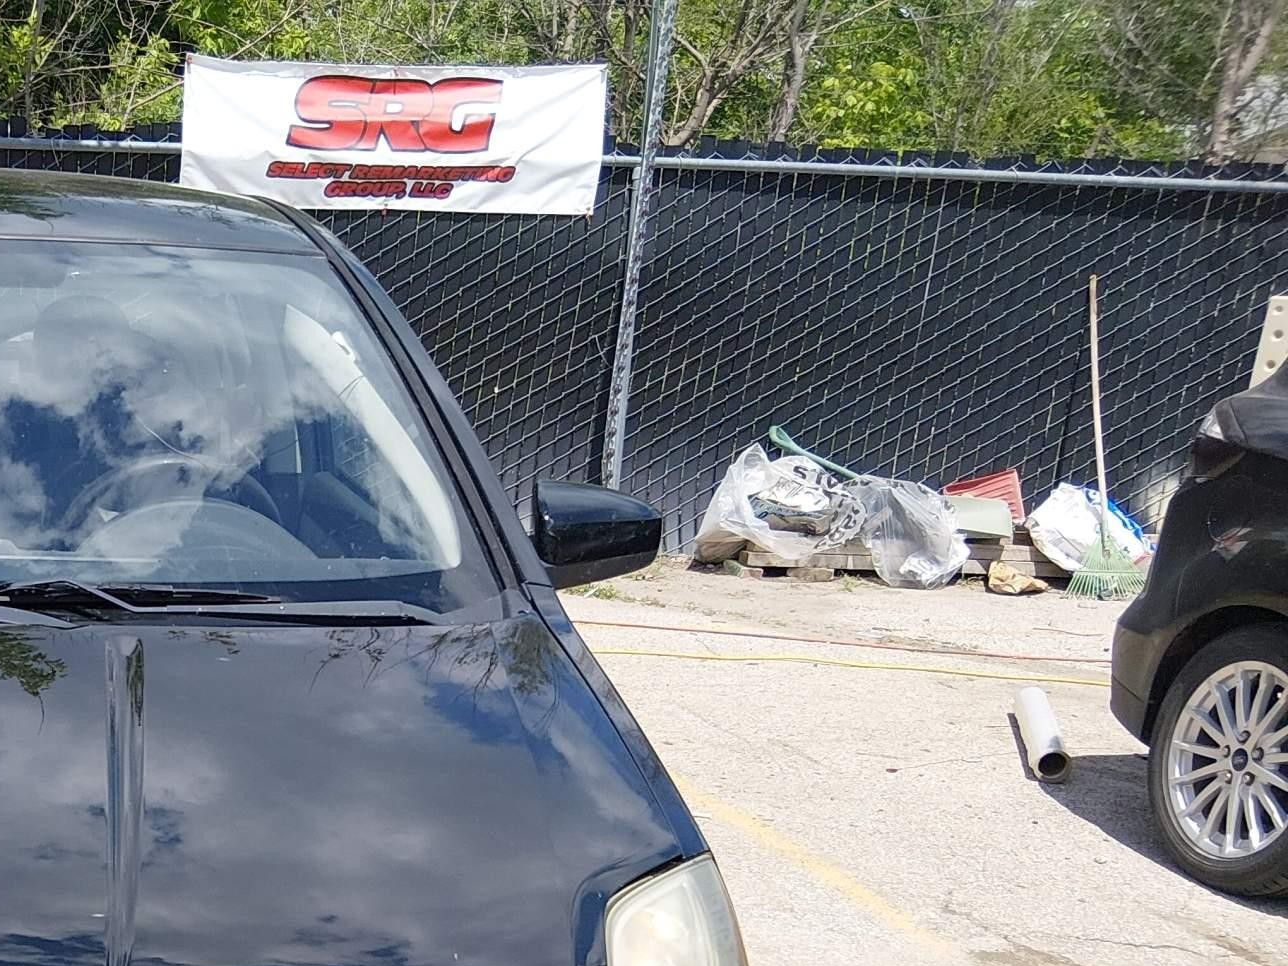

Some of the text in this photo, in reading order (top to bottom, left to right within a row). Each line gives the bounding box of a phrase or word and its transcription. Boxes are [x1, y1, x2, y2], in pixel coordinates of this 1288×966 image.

[285, 75, 504, 154] SRG
[266, 162, 515, 182] SELECT REMARKETING
[324, 180, 454, 199] GROUP, LLC
